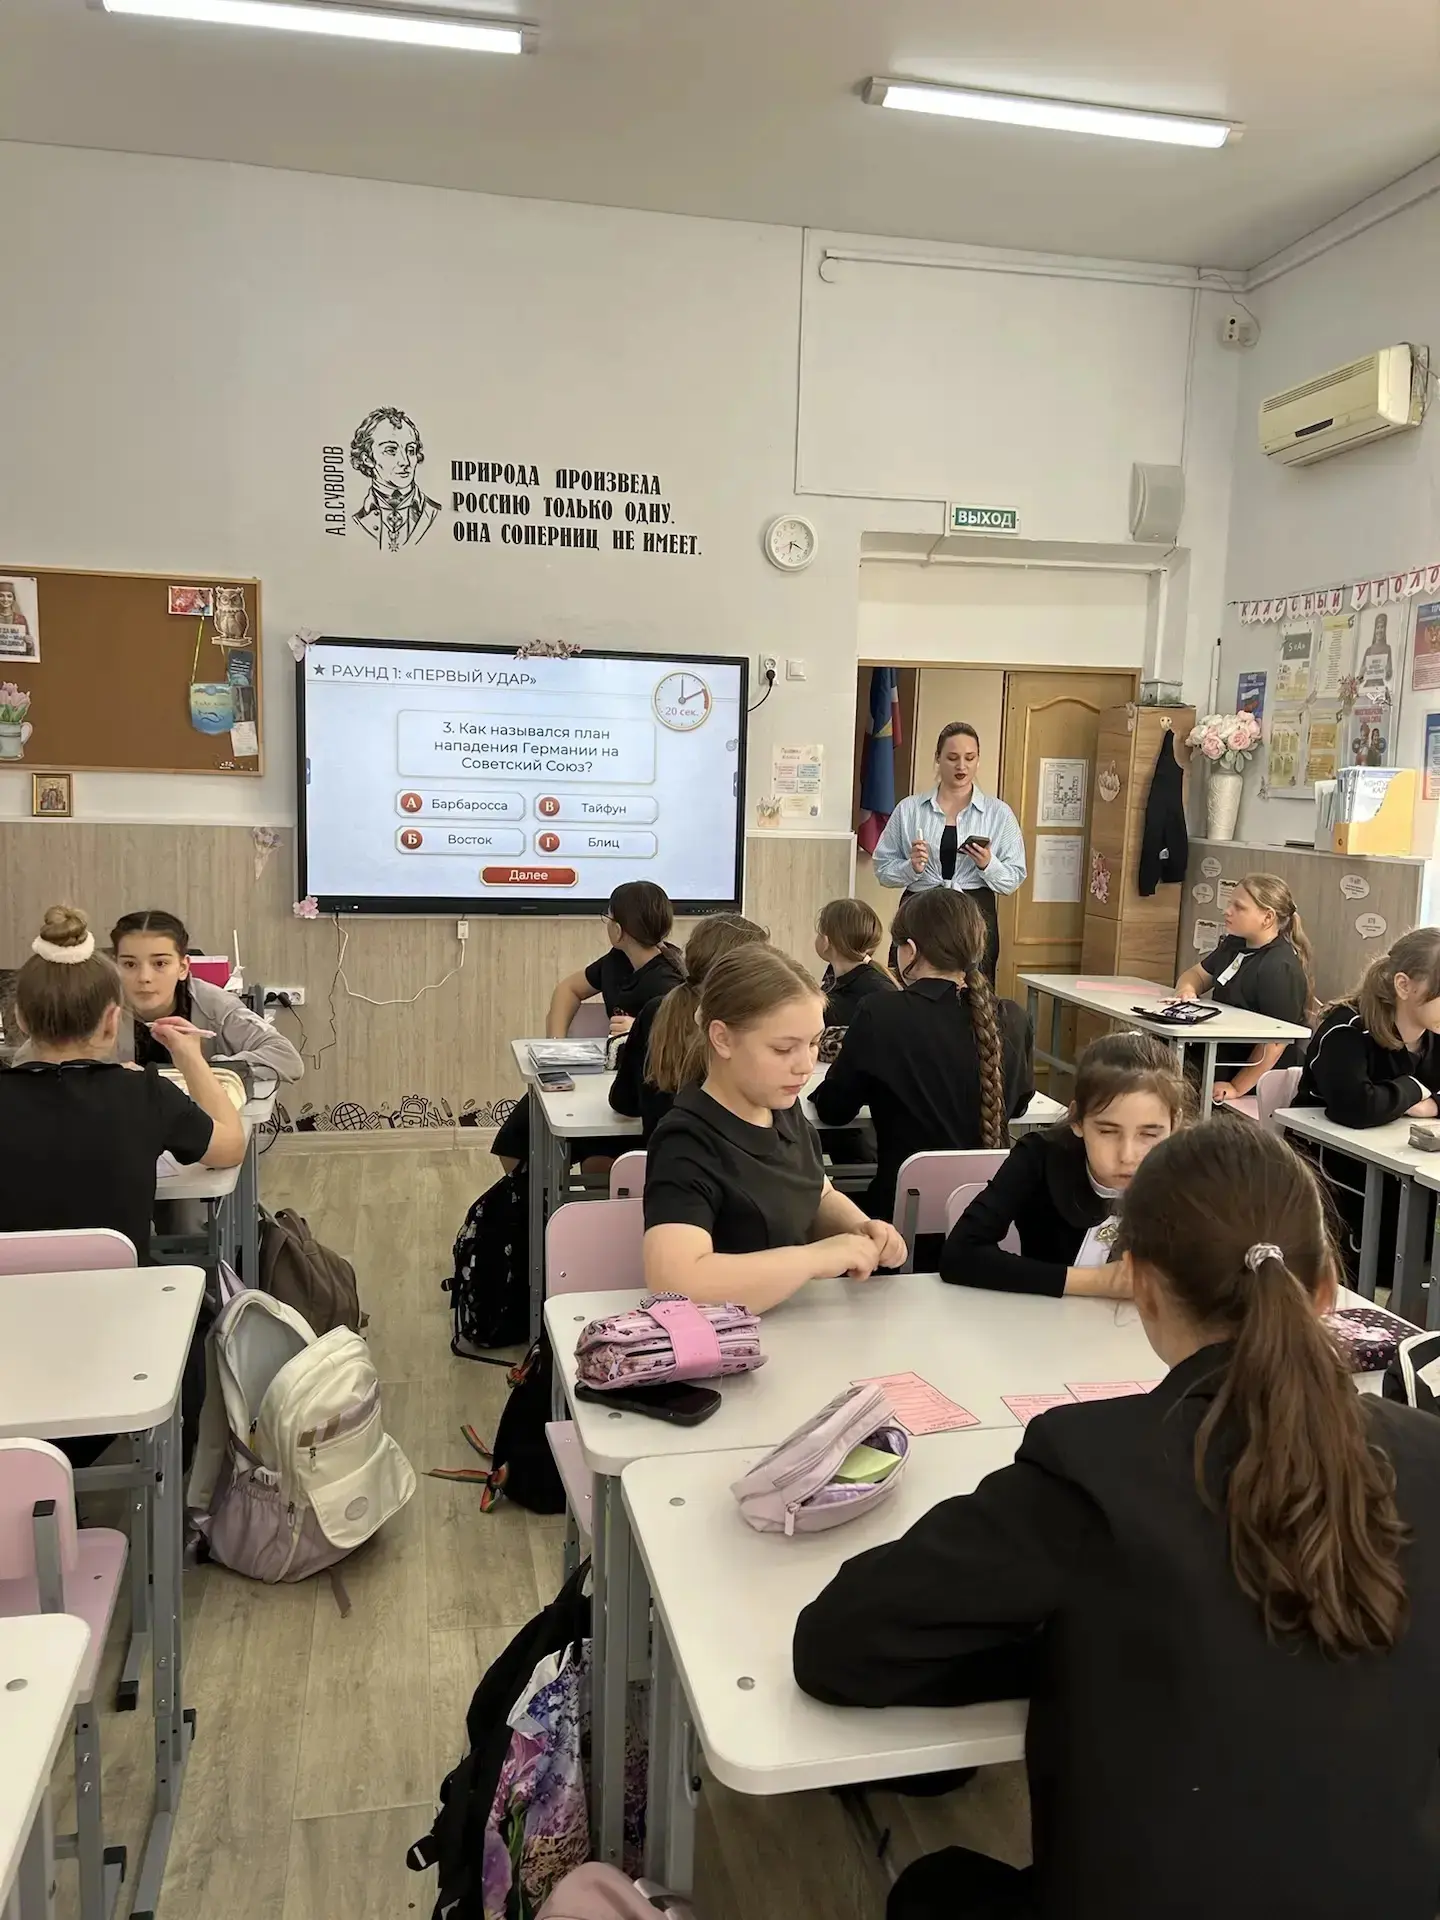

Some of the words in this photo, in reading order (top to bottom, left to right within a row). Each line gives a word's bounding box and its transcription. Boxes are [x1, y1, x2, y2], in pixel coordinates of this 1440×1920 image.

[450, 459, 541, 487] ПРИРОДА
[555, 468, 662, 496] ПРОИЗВЕЛА
[323, 445, 346, 537] А.В.СУВОРОВ
[452, 491, 531, 517] РОССИЮ
[543, 496, 613, 521] ТОЛЬКО
[624, 502, 676, 525] ОДНУ.
[957, 507, 1013, 528] ВЫХОД
[453, 520, 491, 543] ОНА
[500, 523, 600, 551] СОПЕРНИЦ
[612, 529, 636, 550] НЕ
[642, 533, 703, 556] ИМЕЕТ.
[1240, 592, 1341, 617] КЛАССНЫЙ
[1357, 568, 1440, 600] УГОЛО
[332, 664, 389, 681] РАУНД
[393, 667, 402, 680] 1:
[405, 668, 483, 683] «ПЕРВЫЙ
[488, 671, 537, 686] УДАР»
[665, 706, 678, 716] 20
[679, 708, 699, 717] сек.
[442, 721, 455, 734] 3.
[459, 722, 487, 736] Как
[490, 725, 570, 739] назывался
[574, 728, 610, 740] план
[434, 740, 518, 754] нападения
[522, 742, 598, 757] Германии
[601, 747, 619, 757] на
[461, 756, 543, 772] Советский
[545, 759, 593, 773] Союз?
[405, 797, 418, 809] А
[431, 798, 509, 812] Барбаросса
[544, 801, 555, 812] В
[582, 802, 628, 815] Тайфун
[407, 833, 418, 844] Б
[447, 834, 493, 846] Восток
[545, 837, 555, 848] Г
[587, 837, 621, 850] Блиц
[508, 869, 549, 882] Далее
